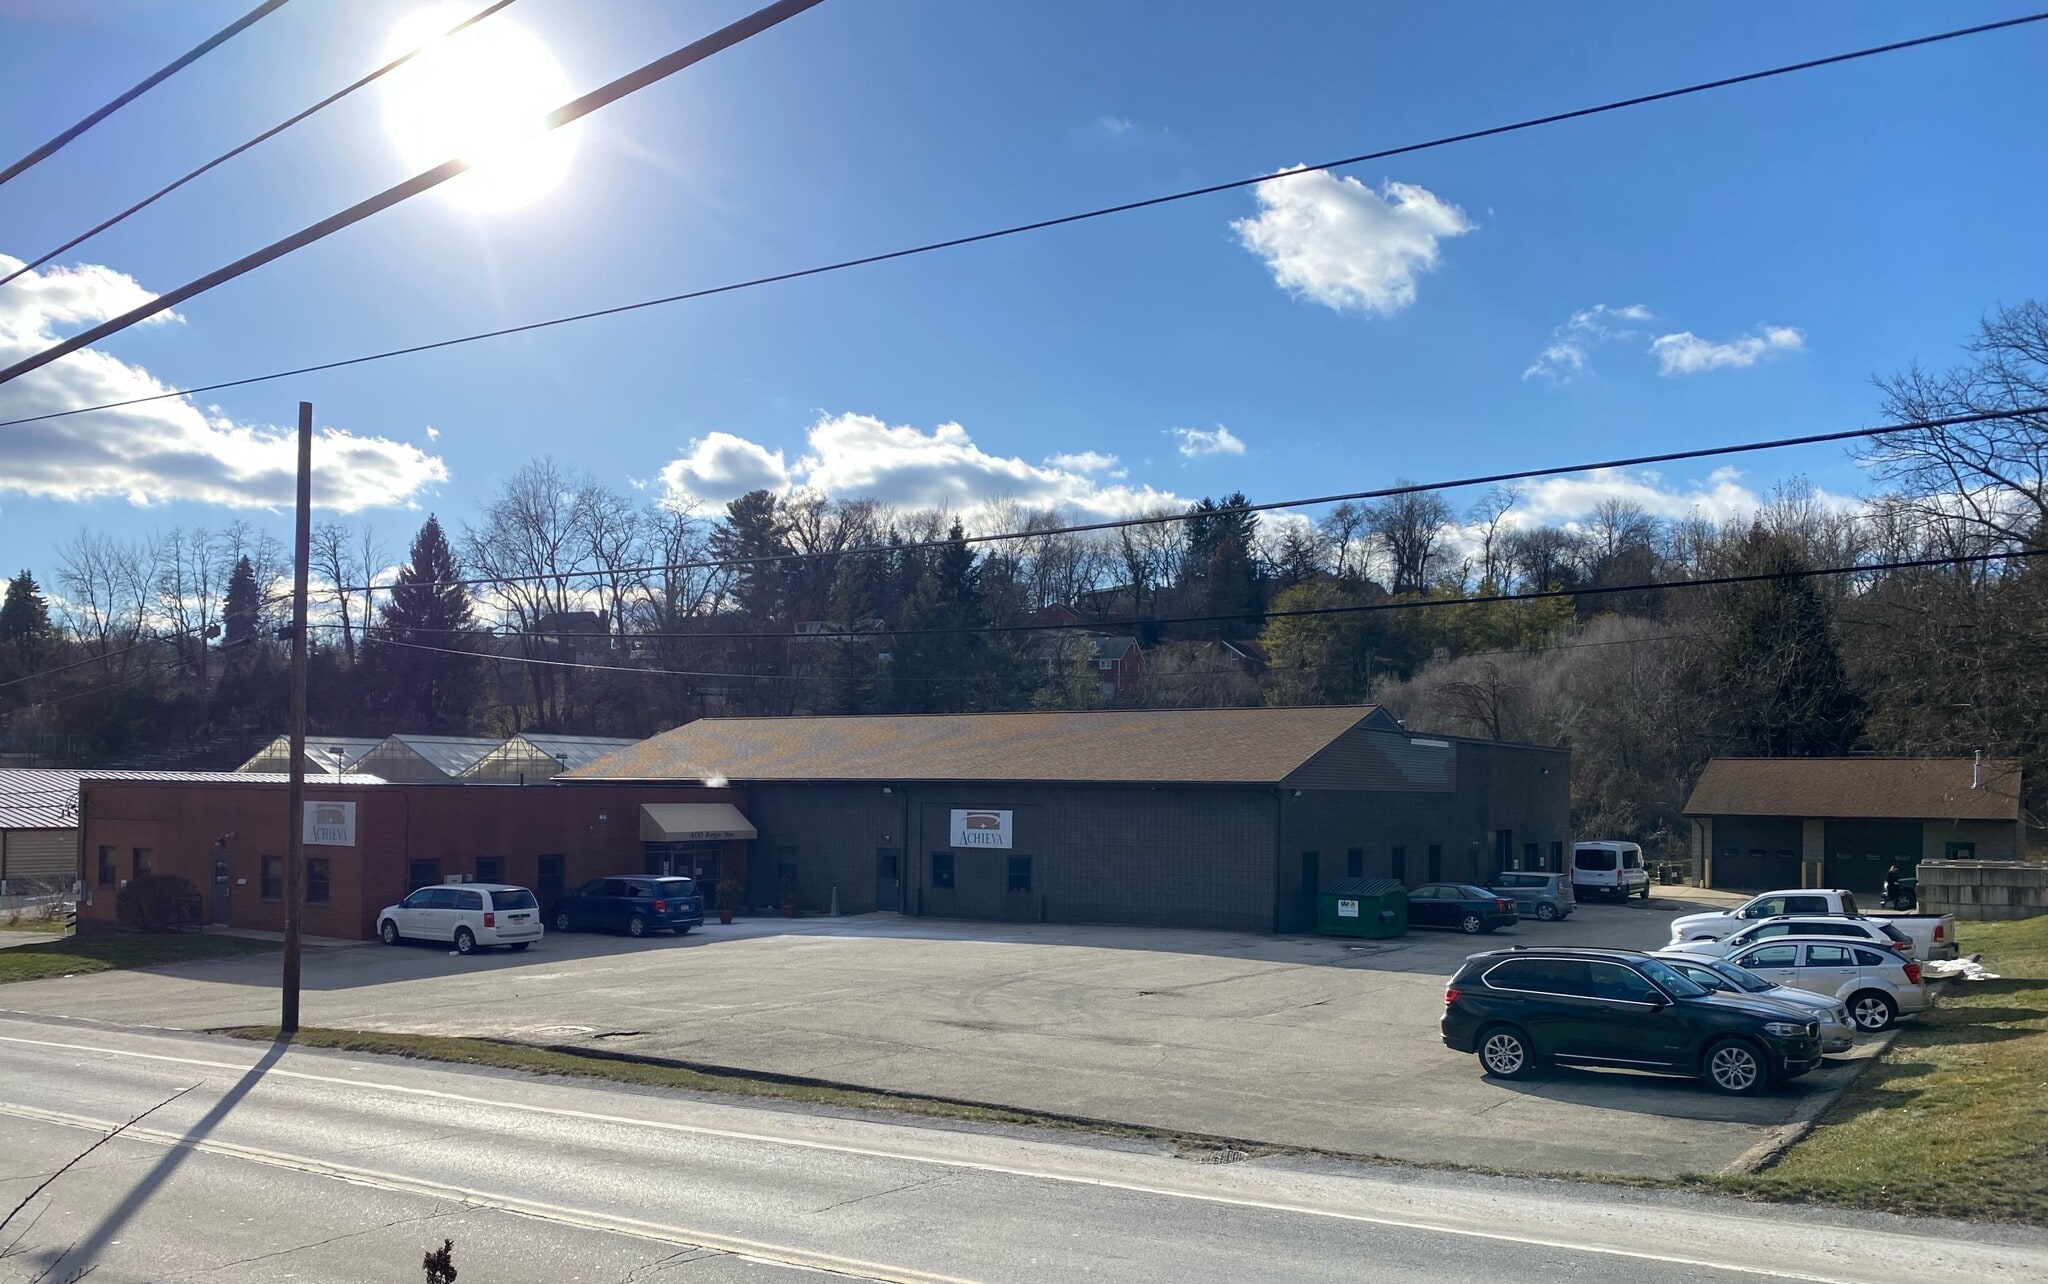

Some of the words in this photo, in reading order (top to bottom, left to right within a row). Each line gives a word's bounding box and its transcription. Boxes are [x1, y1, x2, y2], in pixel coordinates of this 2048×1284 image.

[310, 825, 348, 842] ACHIEVA
[690, 831, 704, 839] 400
[959, 830, 1003, 845] ACHIEVA
